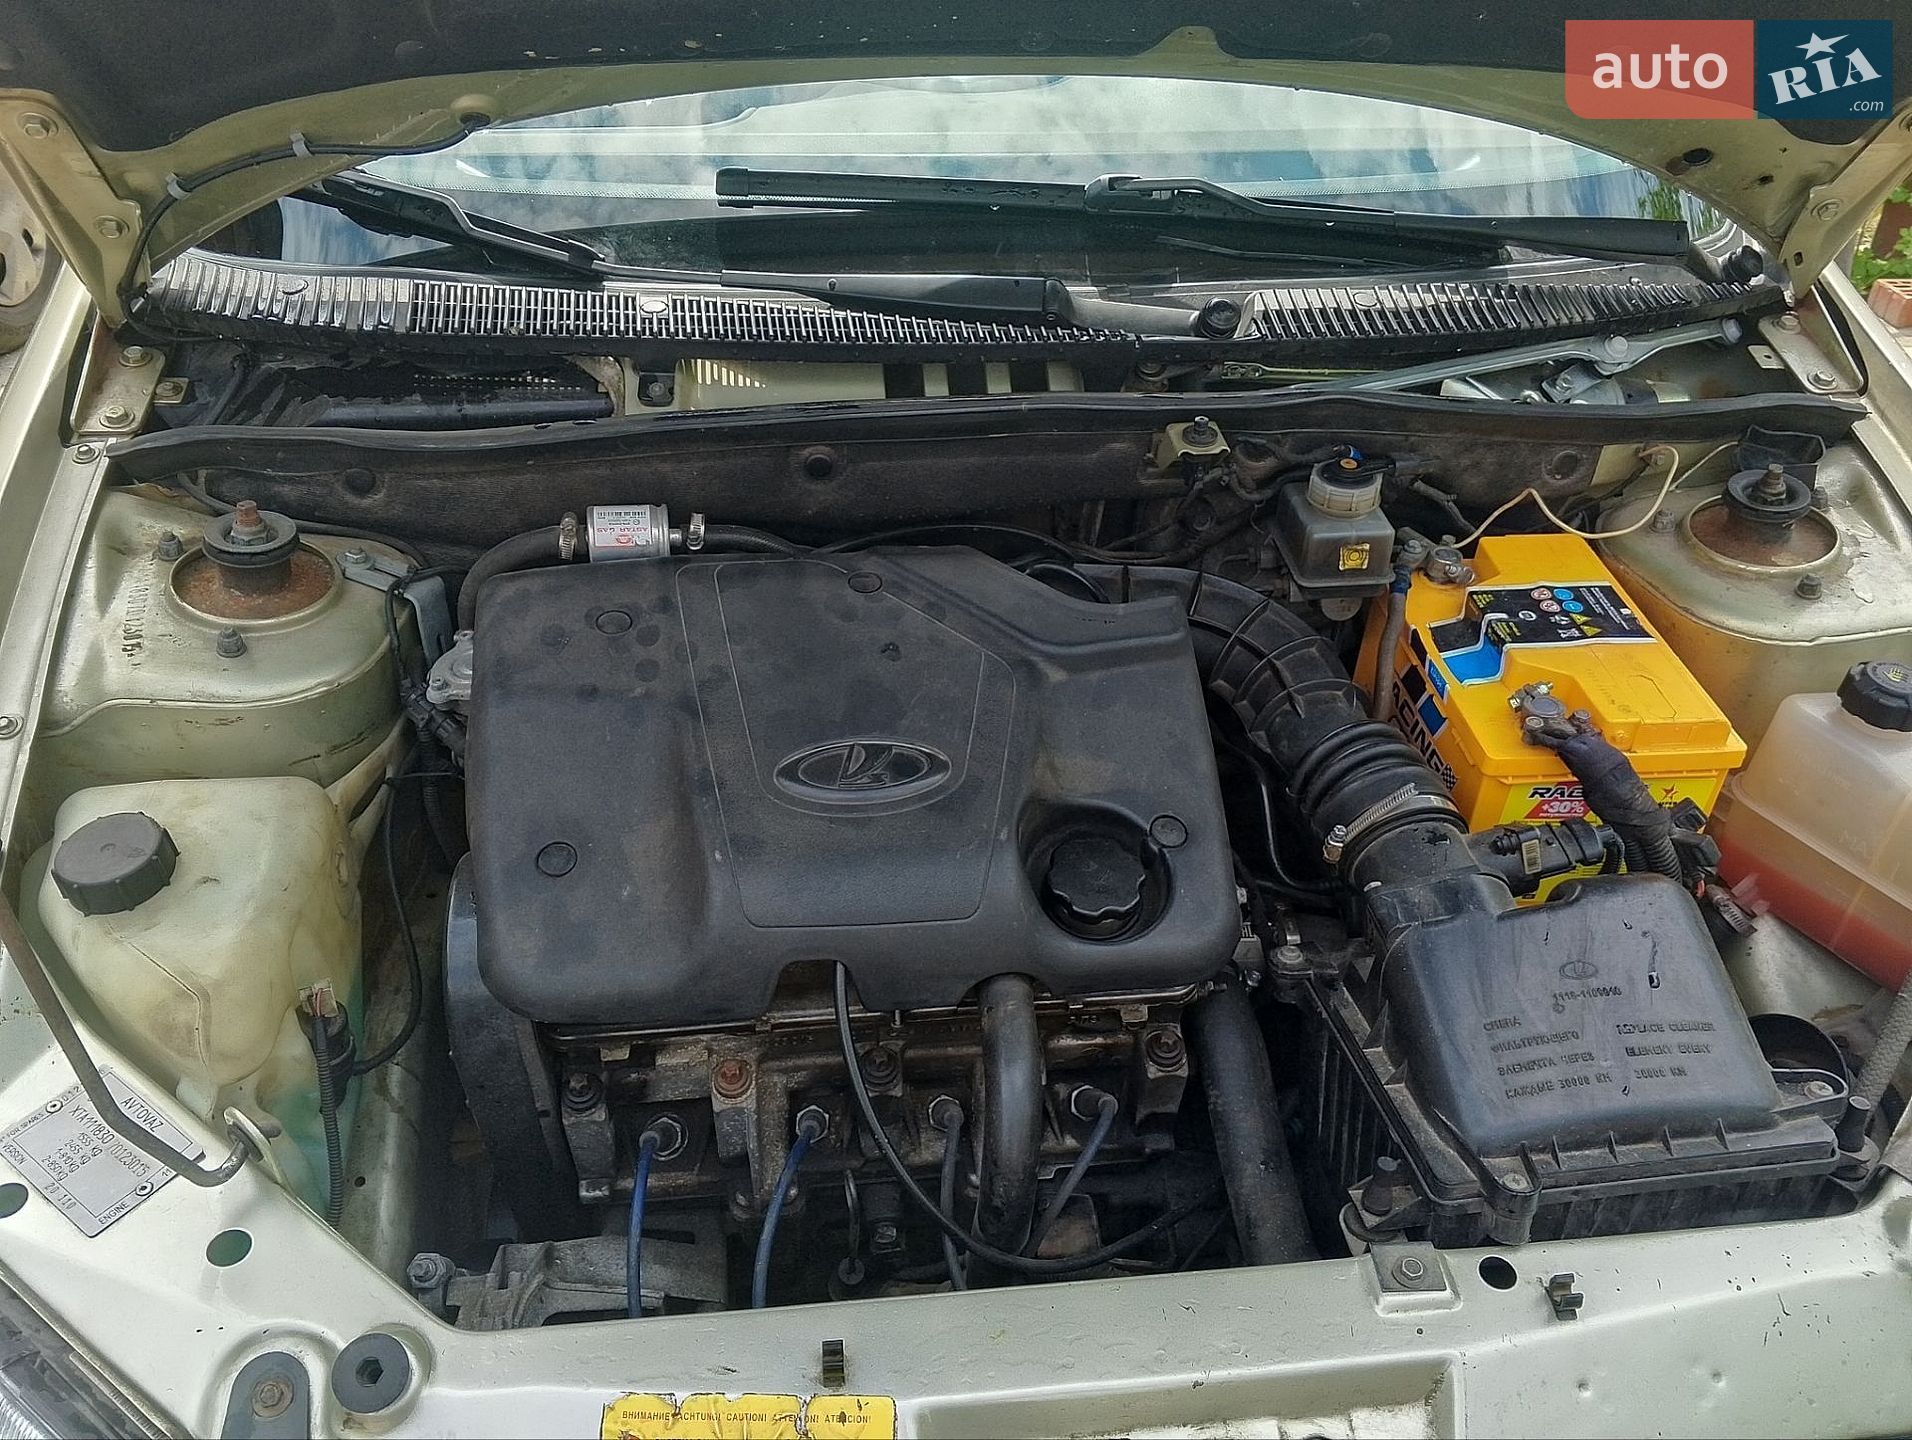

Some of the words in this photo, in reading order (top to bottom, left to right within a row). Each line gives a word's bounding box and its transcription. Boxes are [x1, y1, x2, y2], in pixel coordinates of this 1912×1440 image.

[1392, 680, 1445, 774] ACING
[1542, 801, 1584, 813] +30%
[120, 1095, 164, 1133] AVTOVAZ
[98, 1201, 130, 1225] ENGINE
[726, 1413, 767, 1423] CAUTION!
[824, 1414, 872, 1425] ATECION!
